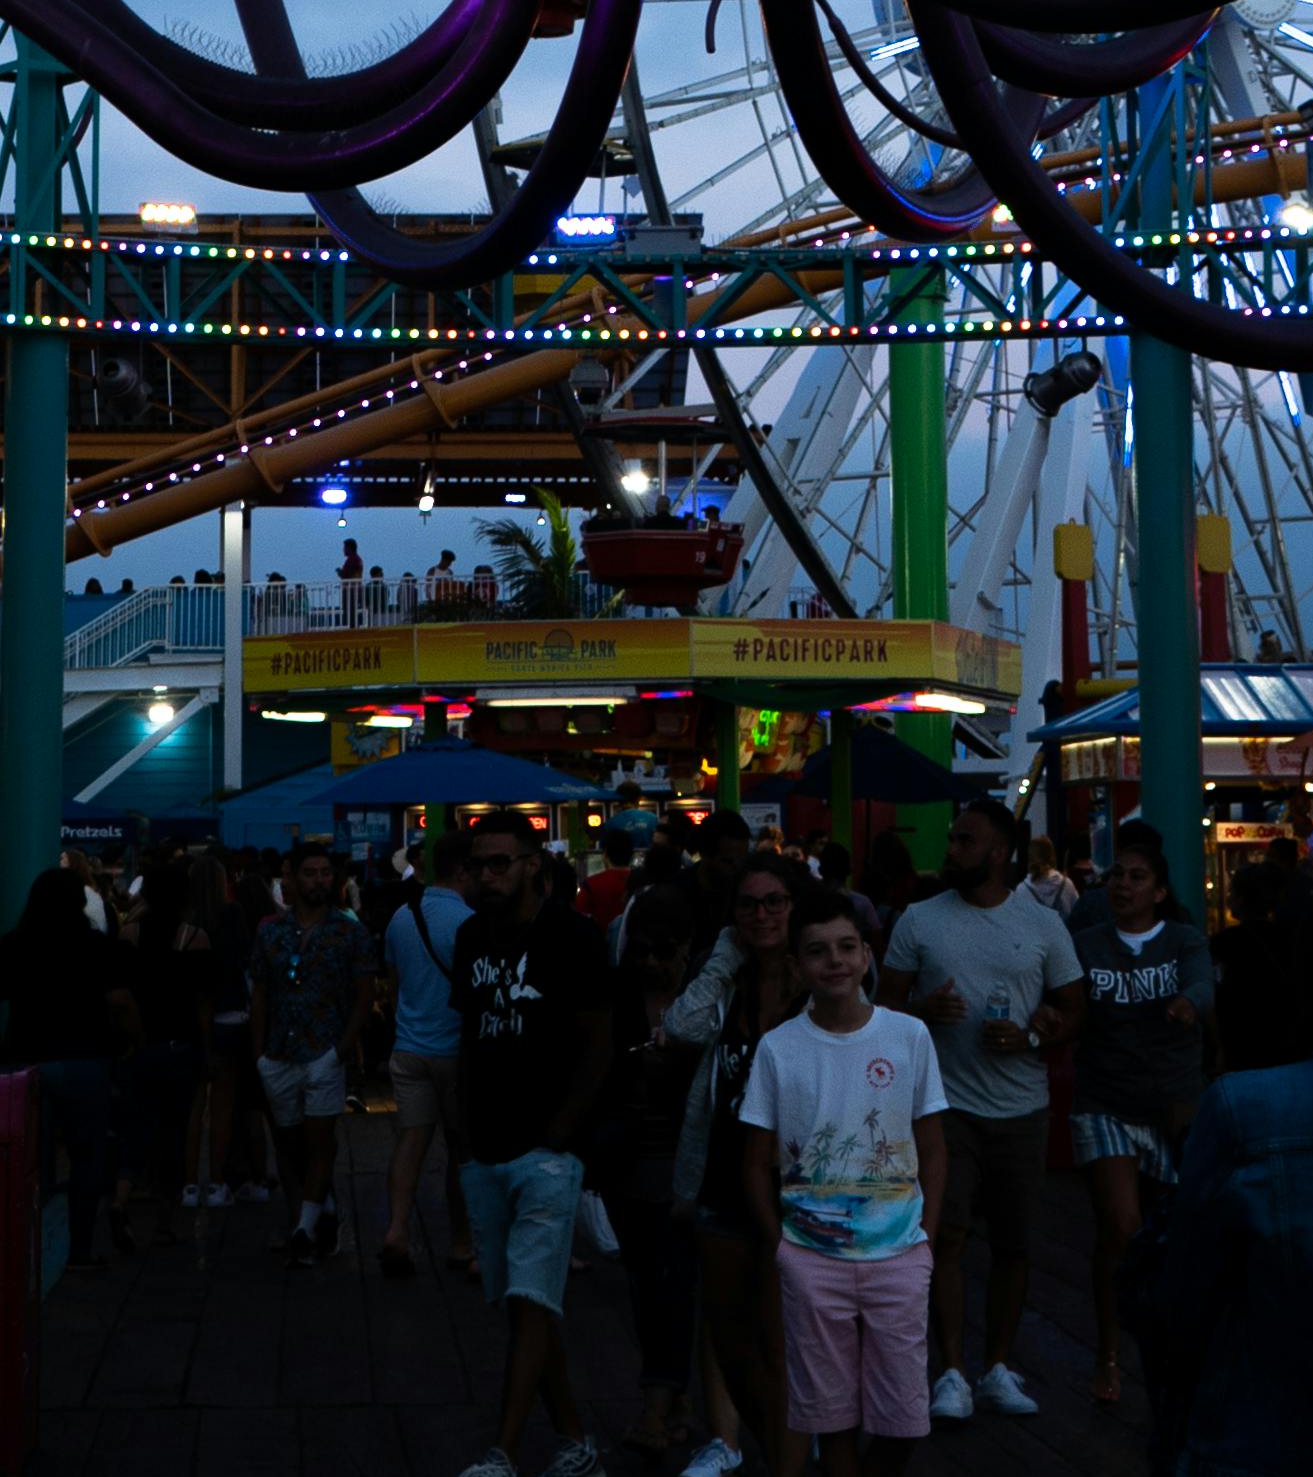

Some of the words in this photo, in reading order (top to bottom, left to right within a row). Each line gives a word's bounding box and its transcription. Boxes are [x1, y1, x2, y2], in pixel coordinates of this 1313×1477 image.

[271, 646, 382, 677] #PACIFICPARK
[485, 640, 538, 661] PACIFIC
[580, 639, 617, 659] PARK
[733, 637, 888, 663] #PACIFICPARK
[60, 825, 124, 839] Pretzels
[471, 953, 513, 989] She's
[1089, 958, 1180, 1004] PINK
[494, 986, 505, 1009] A
